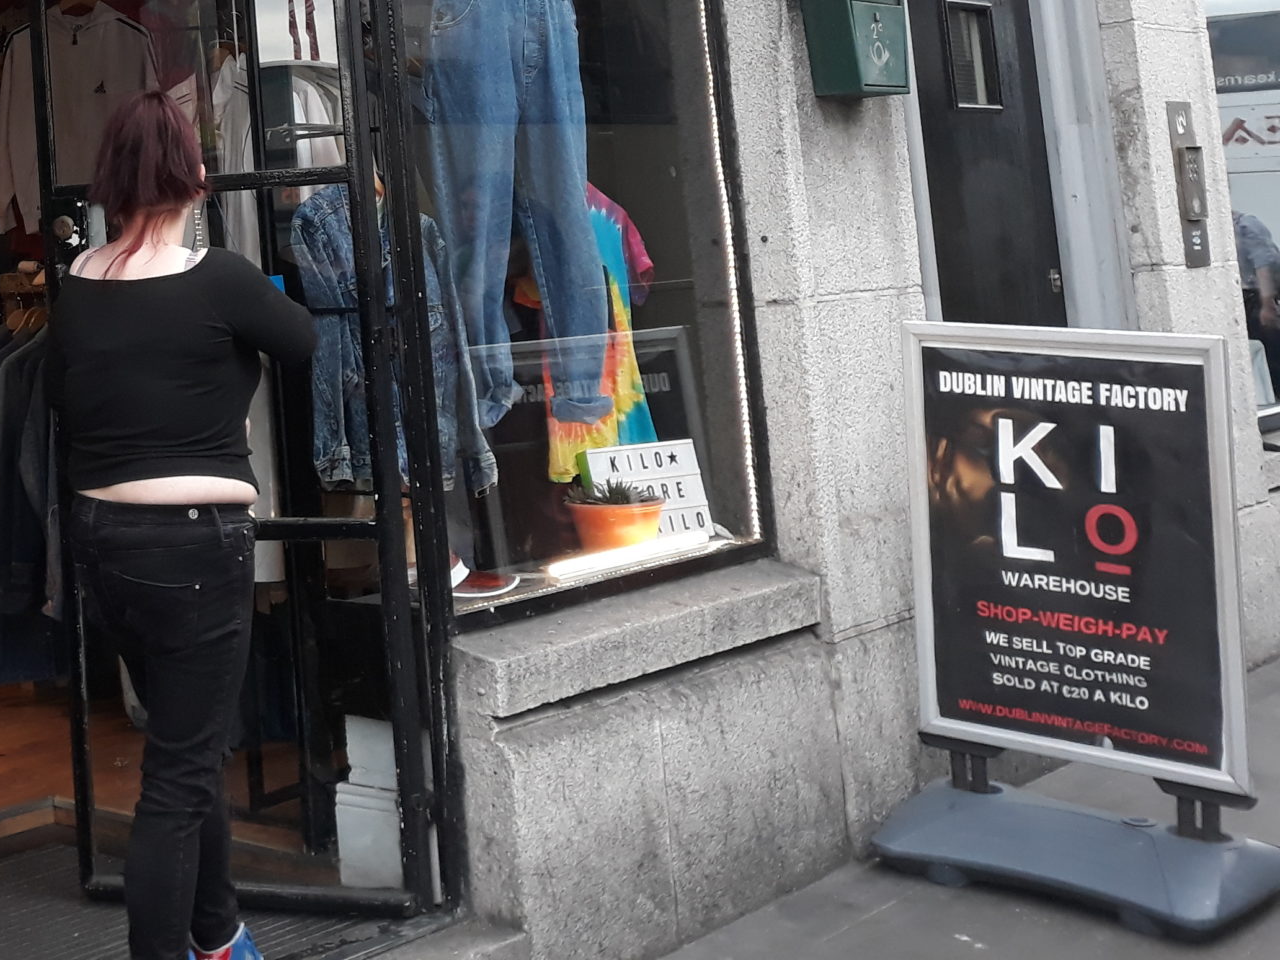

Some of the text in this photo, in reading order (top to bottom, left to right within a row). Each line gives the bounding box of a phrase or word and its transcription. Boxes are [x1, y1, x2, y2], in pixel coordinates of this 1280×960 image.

[938, 370, 1189, 412] DUBLIN VINTAGE FACTORY
[609, 451, 664, 473] KILO
[1001, 570, 1131, 603] WAREHOUSE
[976, 600, 1169, 645] SHOP-WEIGH-PAY
[985, 630, 1152, 671] WE SELL TOP GRADE
[990, 652, 1148, 689] VINTAGE CLOTHING
[992, 672, 1150, 711] SOLD AT €20 A KILO
[958, 698, 1209, 756] WWW.DUBLINVINTAGEFACTORY.COM
